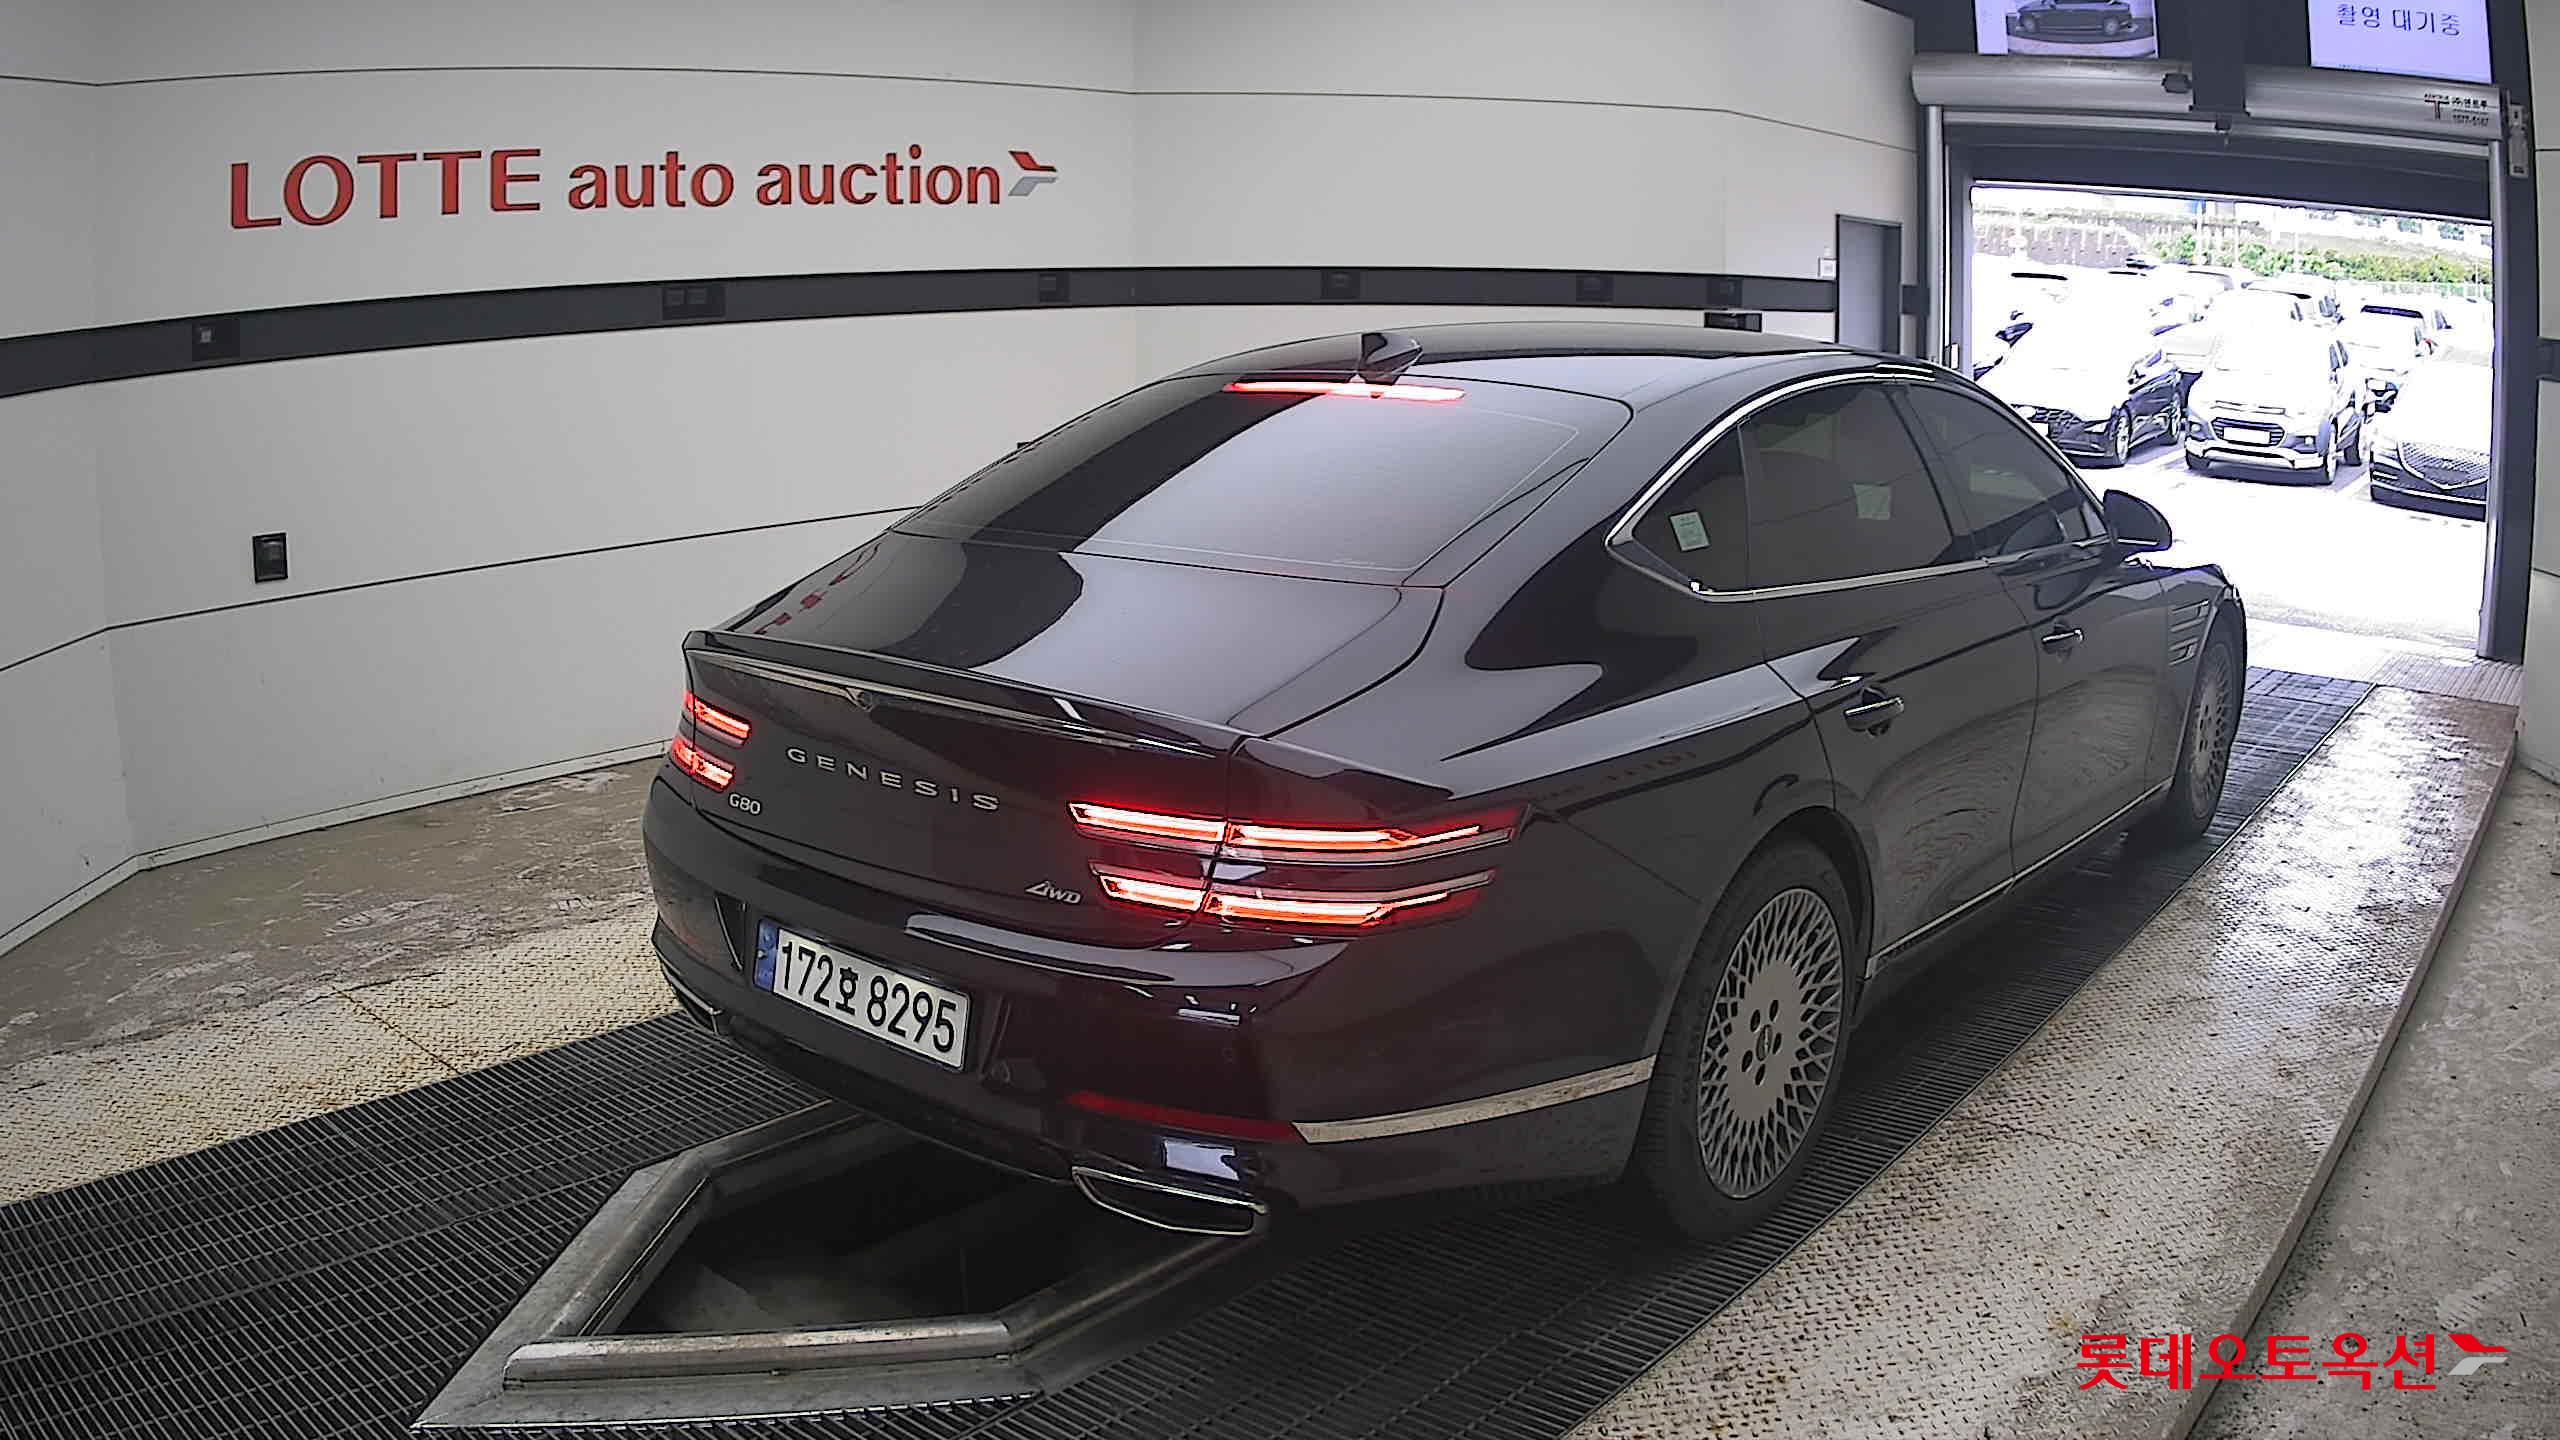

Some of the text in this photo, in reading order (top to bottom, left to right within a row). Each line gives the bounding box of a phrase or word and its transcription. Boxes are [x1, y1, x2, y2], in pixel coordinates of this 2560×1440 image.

[2337, 3, 2460, 36] 촬영 대기중
[230, 144, 1001, 228] LOTTE auto auction
[786, 746, 1000, 811] GENESIS
[729, 793, 761, 815] G80
[1025, 880, 1081, 904] AWD
